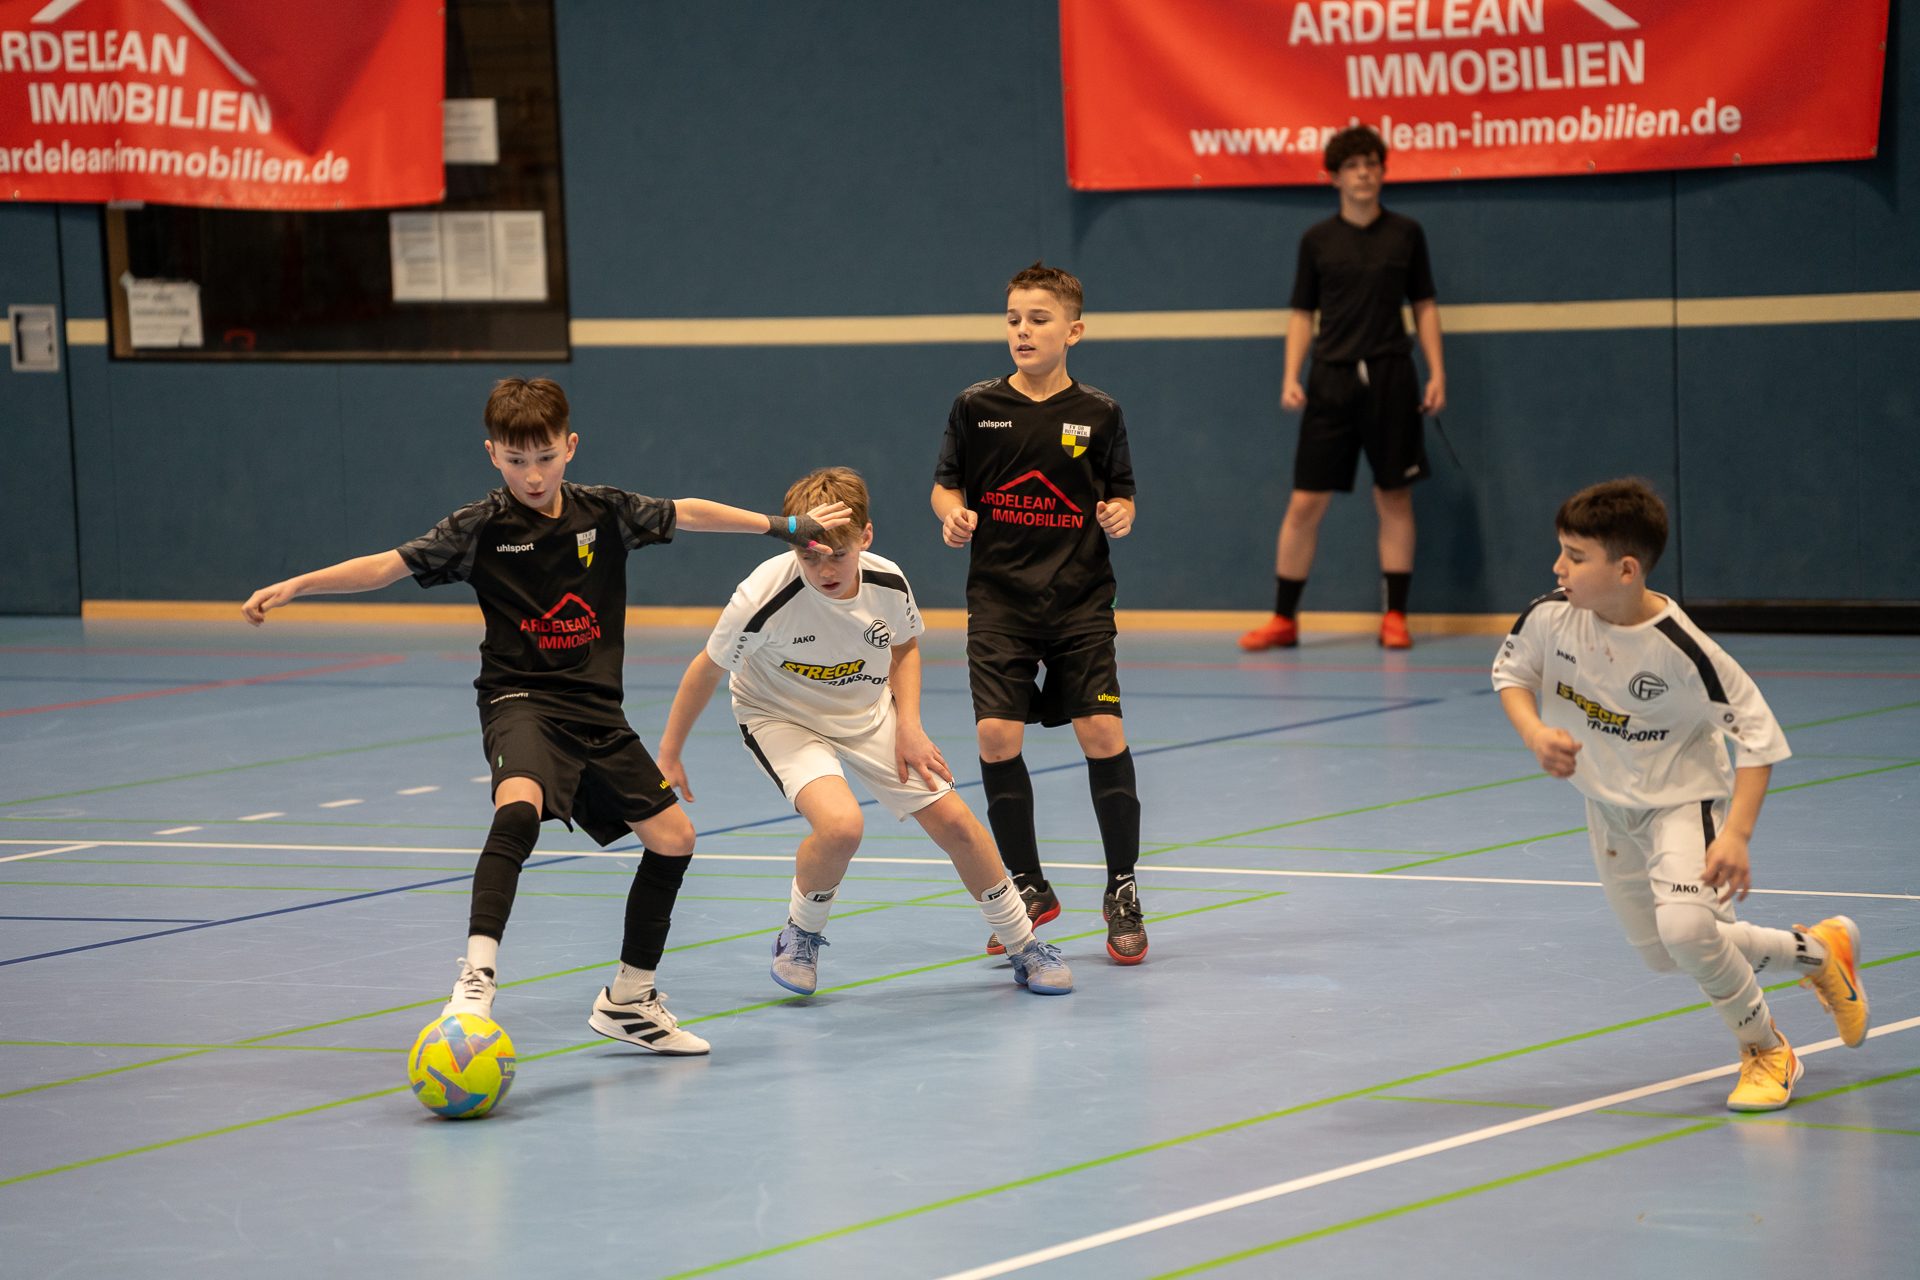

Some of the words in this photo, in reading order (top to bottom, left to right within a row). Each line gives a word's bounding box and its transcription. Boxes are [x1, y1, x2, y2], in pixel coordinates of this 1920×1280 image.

[1288, 0, 1545, 45] ARDELEAN
[0, 29, 188, 76] RDELEAN
[1346, 39, 1645, 98] IMMOBILIEN
[28, 81, 272, 134] IMMOBILIEN
[1190, 97, 1741, 156] www.arlean-immobilien.de
[978, 420, 1012, 429] uhlsport
[992, 508, 1083, 528] IMMOBILIEN
[496, 543, 534, 553] uhlsport
[520, 615, 591, 633] ARDELEAN
[792, 635, 815, 644] JAKO
[779, 659, 866, 681] STRECK
[1587, 719, 1669, 742] TRANSPORT
[1671, 883, 1699, 894] JAKO
